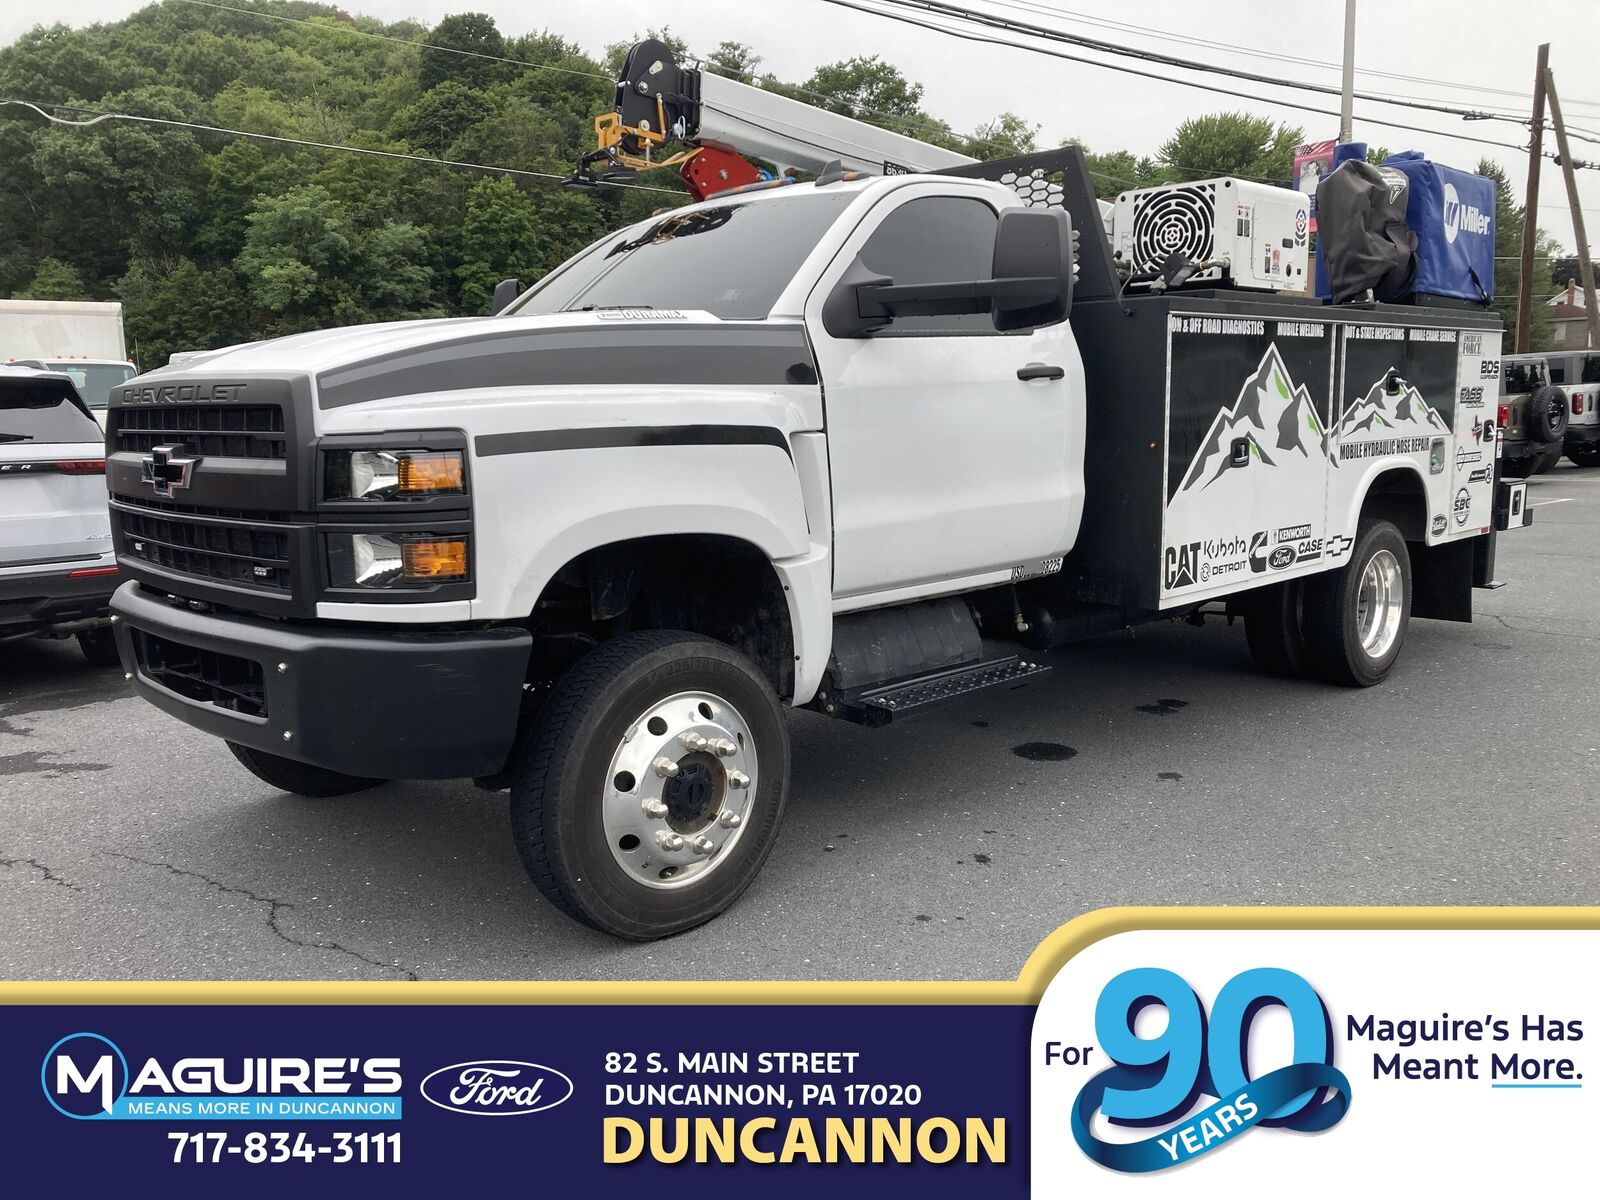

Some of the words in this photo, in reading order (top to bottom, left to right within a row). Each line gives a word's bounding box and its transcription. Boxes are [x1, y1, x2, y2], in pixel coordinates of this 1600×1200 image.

[1460, 204, 1491, 235] Miller
[621, 310, 688, 320] DURAMAX
[1189, 317, 1202, 333] OFF
[1202, 318, 1221, 334] ROAD
[1277, 322, 1299, 336] MOBILE
[1299, 323, 1325, 338] WELDING
[1375, 327, 1405, 340] INSPECTIONS
[1409, 328, 1426, 341] MOBILE
[1462, 342, 1482, 355] FORCE
[1480, 360, 1500, 374] BDS
[122, 384, 247, 404] CHEVROLET
[1339, 443, 1363, 461] MOBILE
[1363, 440, 1396, 458] HYDRAULIC
[1396, 438, 1411, 454] HOSE
[1279, 526, 1311, 541] KENWORTH
[1203, 535, 1246, 559] Kubota
[1298, 538, 1324, 555] CASE
[1164, 541, 1201, 590] CAT
[1212, 560, 1247, 576] DETROIT
